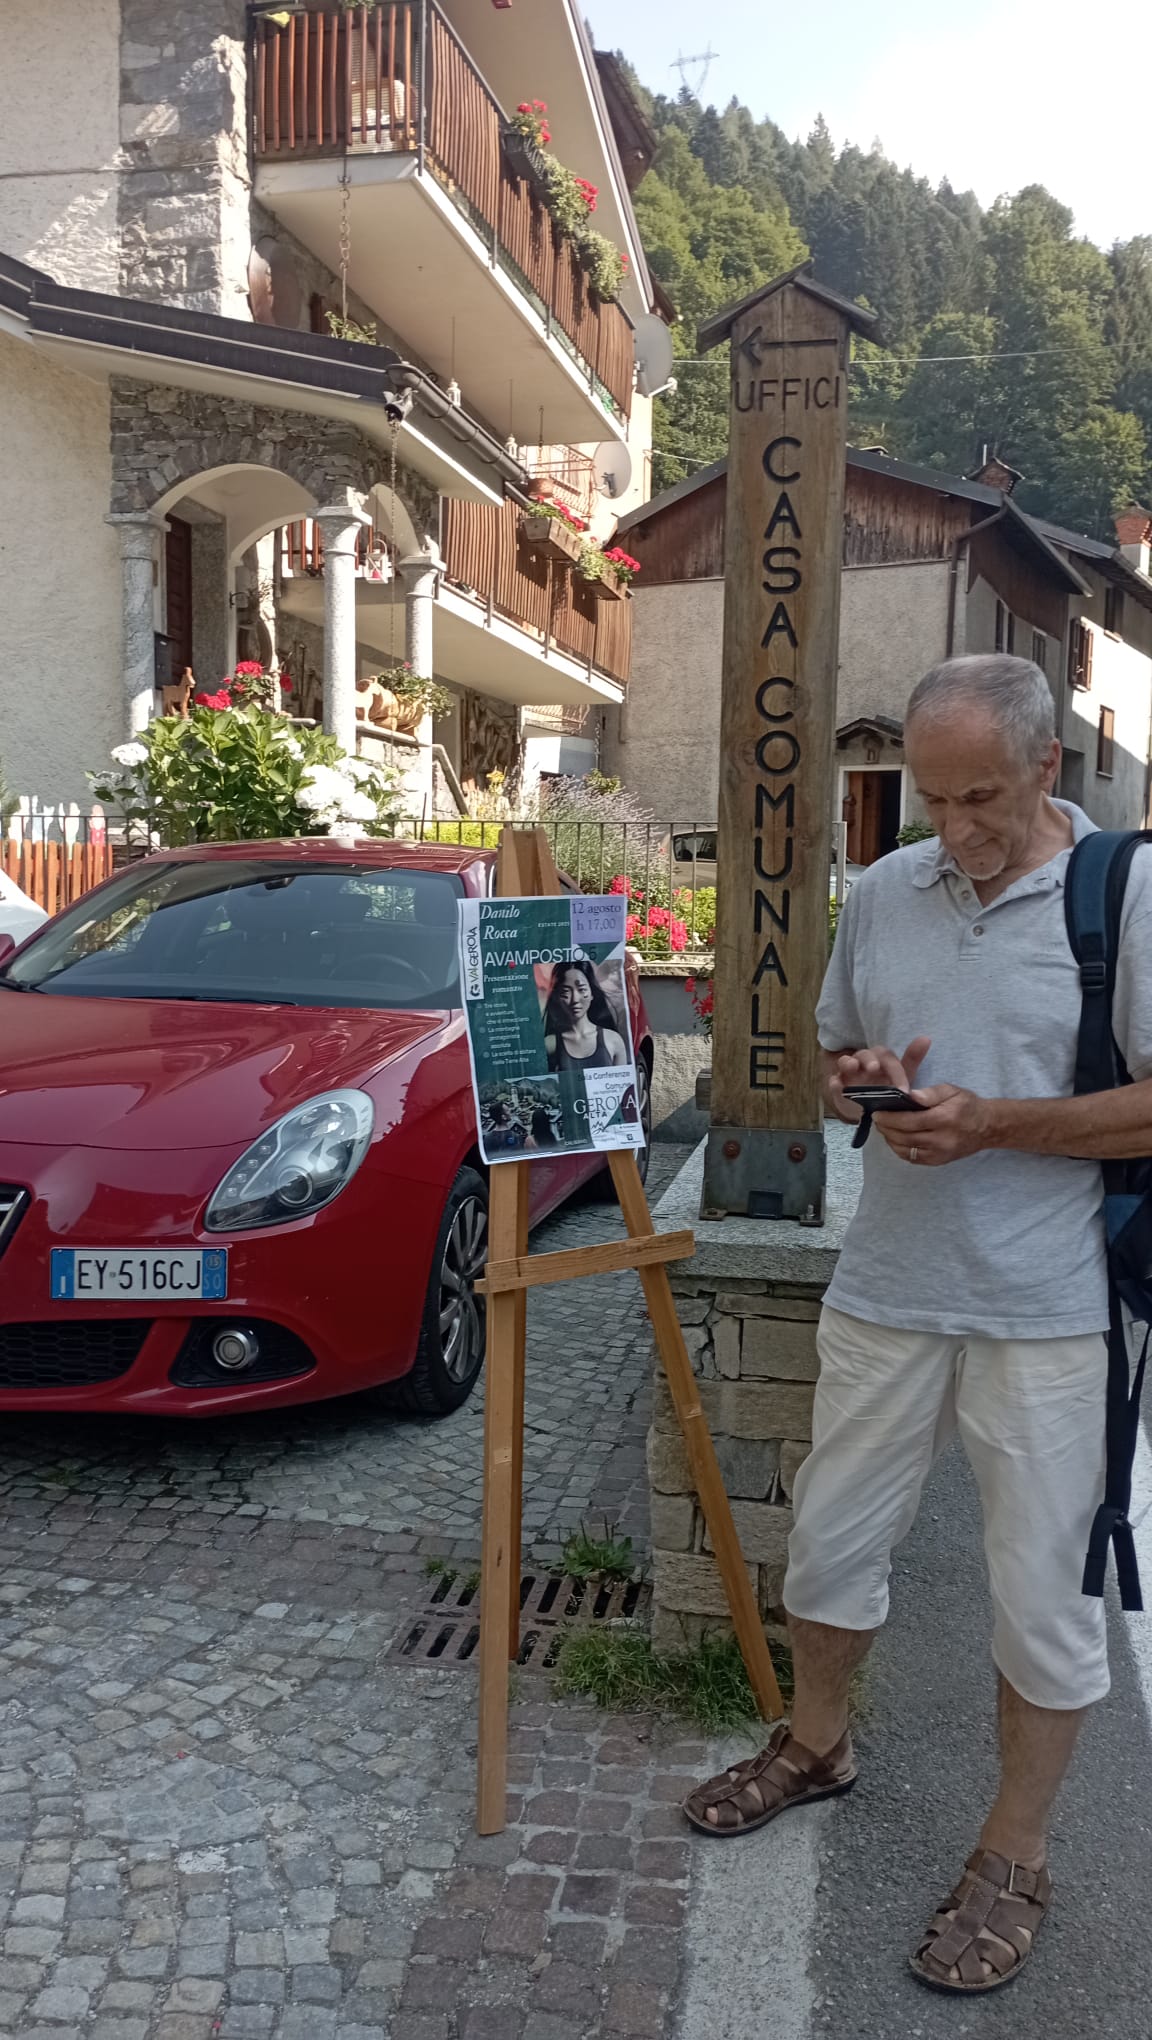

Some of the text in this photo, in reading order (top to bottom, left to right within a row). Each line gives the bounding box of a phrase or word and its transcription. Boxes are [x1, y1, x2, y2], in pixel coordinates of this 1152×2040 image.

[734, 376, 840, 413] UFFICI
[761, 436, 802, 649] CASA
[750, 676, 801, 1090] COMUNALE
[480, 905, 520, 920] Danilo
[572, 903, 622, 916] 12 agosto
[483, 925, 518, 940] Rocca
[576, 919, 585, 931] h
[484, 947, 585, 967] AVAMPOSTO
[484, 973, 529, 983] Presentazione
[573, 1094, 638, 1114] GEROLA
[583, 1111, 608, 1121] ALTA
